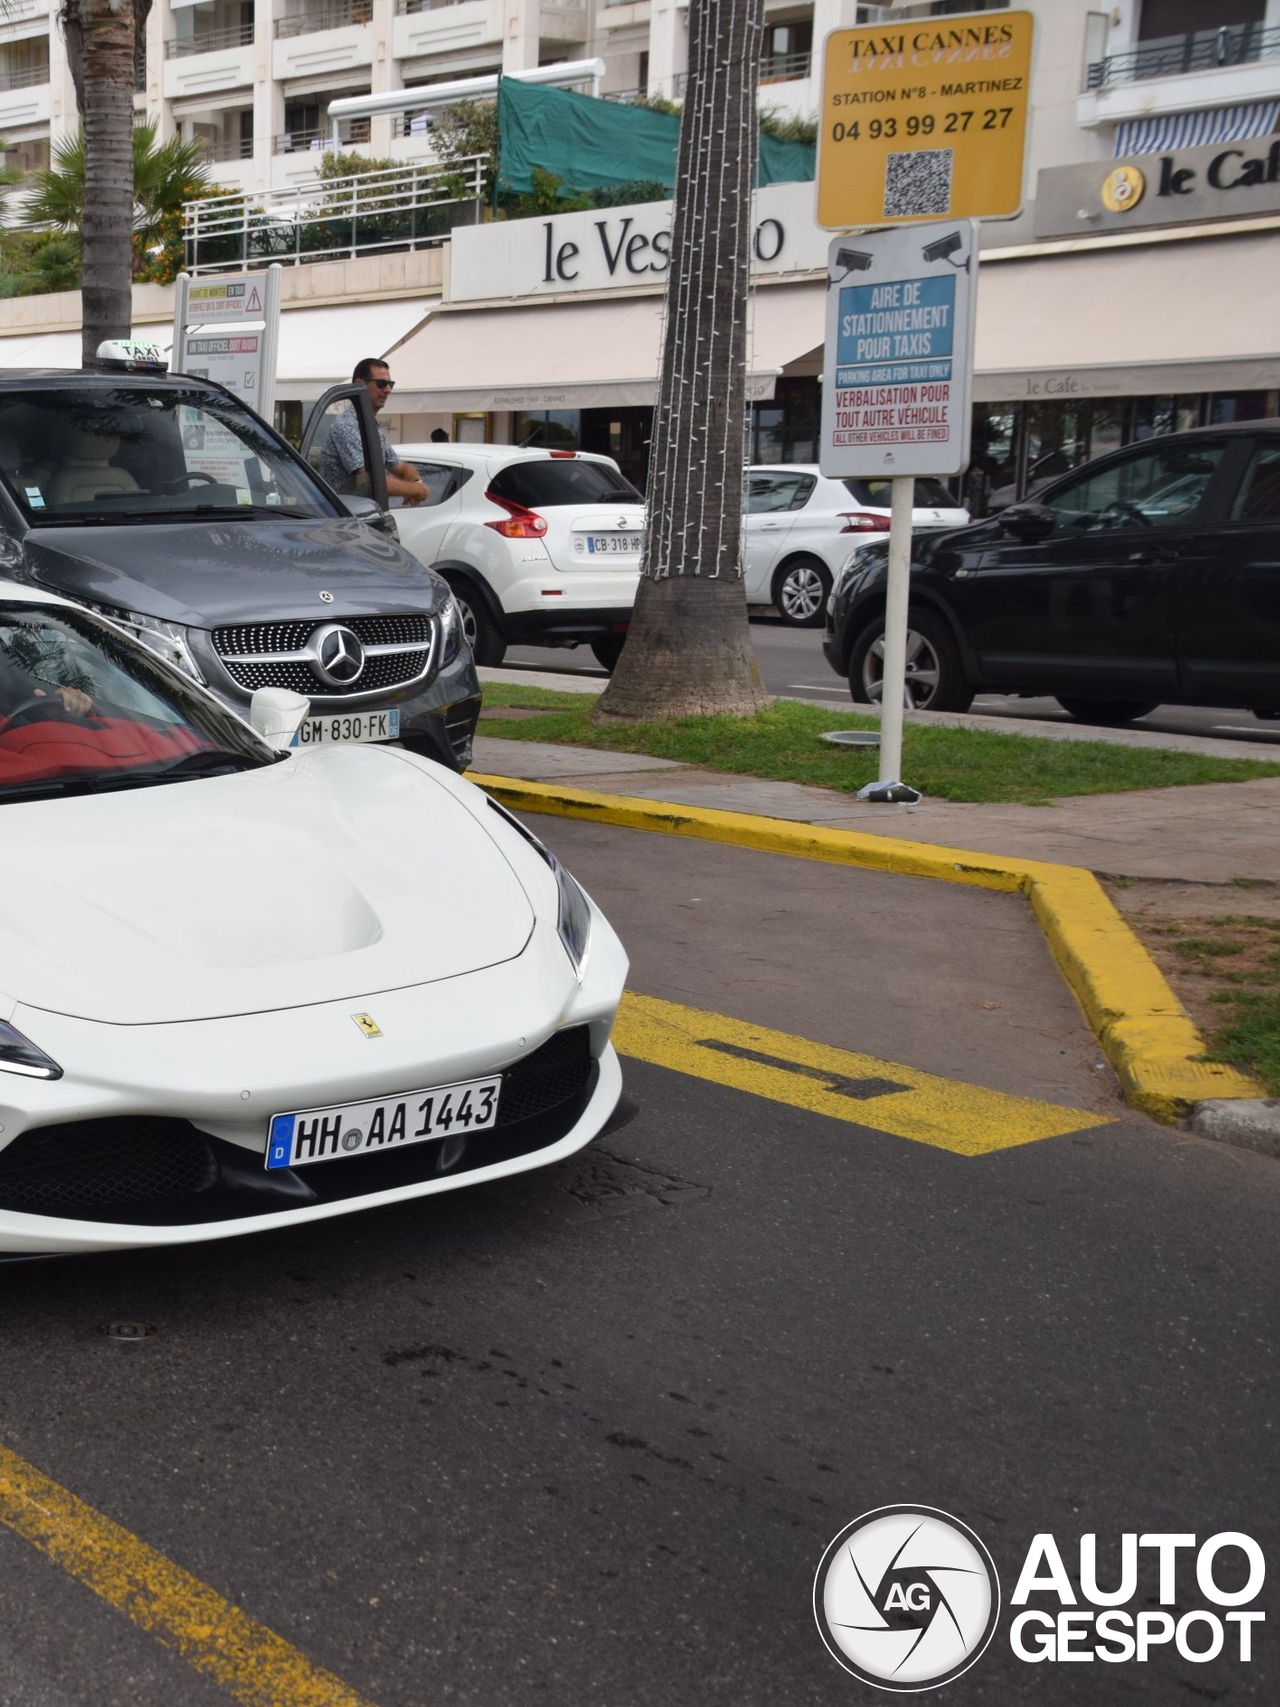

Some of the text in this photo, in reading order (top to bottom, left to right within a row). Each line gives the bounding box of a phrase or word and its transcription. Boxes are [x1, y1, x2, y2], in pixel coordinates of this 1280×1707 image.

[849, 24, 1013, 58] TAXI CANNES
[832, 89, 896, 106] STATION
[901, 86, 926, 100] N°8
[940, 77, 1023, 96] MARTINEZ
[832, 107, 1013, 142] 04 93 99 27 27
[1156, 156, 1197, 197] le
[542, 217, 785, 282] le Veso
[871, 282, 921, 309] AIRE DE
[842, 305, 950, 337] STATIONNEMENT
[122, 346, 160, 357] TAXI
[857, 333, 932, 360] POUR TAXIS
[837, 364, 950, 385] PARKING AREA FOR TAXI ONLY
[1026, 379, 1040, 395] le
[1045, 376, 1078, 394] Café
[836, 385, 950, 408] VERBALISATION POUR
[836, 404, 948, 428] TOUT AUTRE VÉHICULE
[835, 428, 947, 443] ALL OTHER VEHICLES WILL BE FINED
[301, 714, 387, 743] GM-830-FK
[295, 1085, 497, 1159] HH AA 1443
[274, 1147, 284, 1159] D
